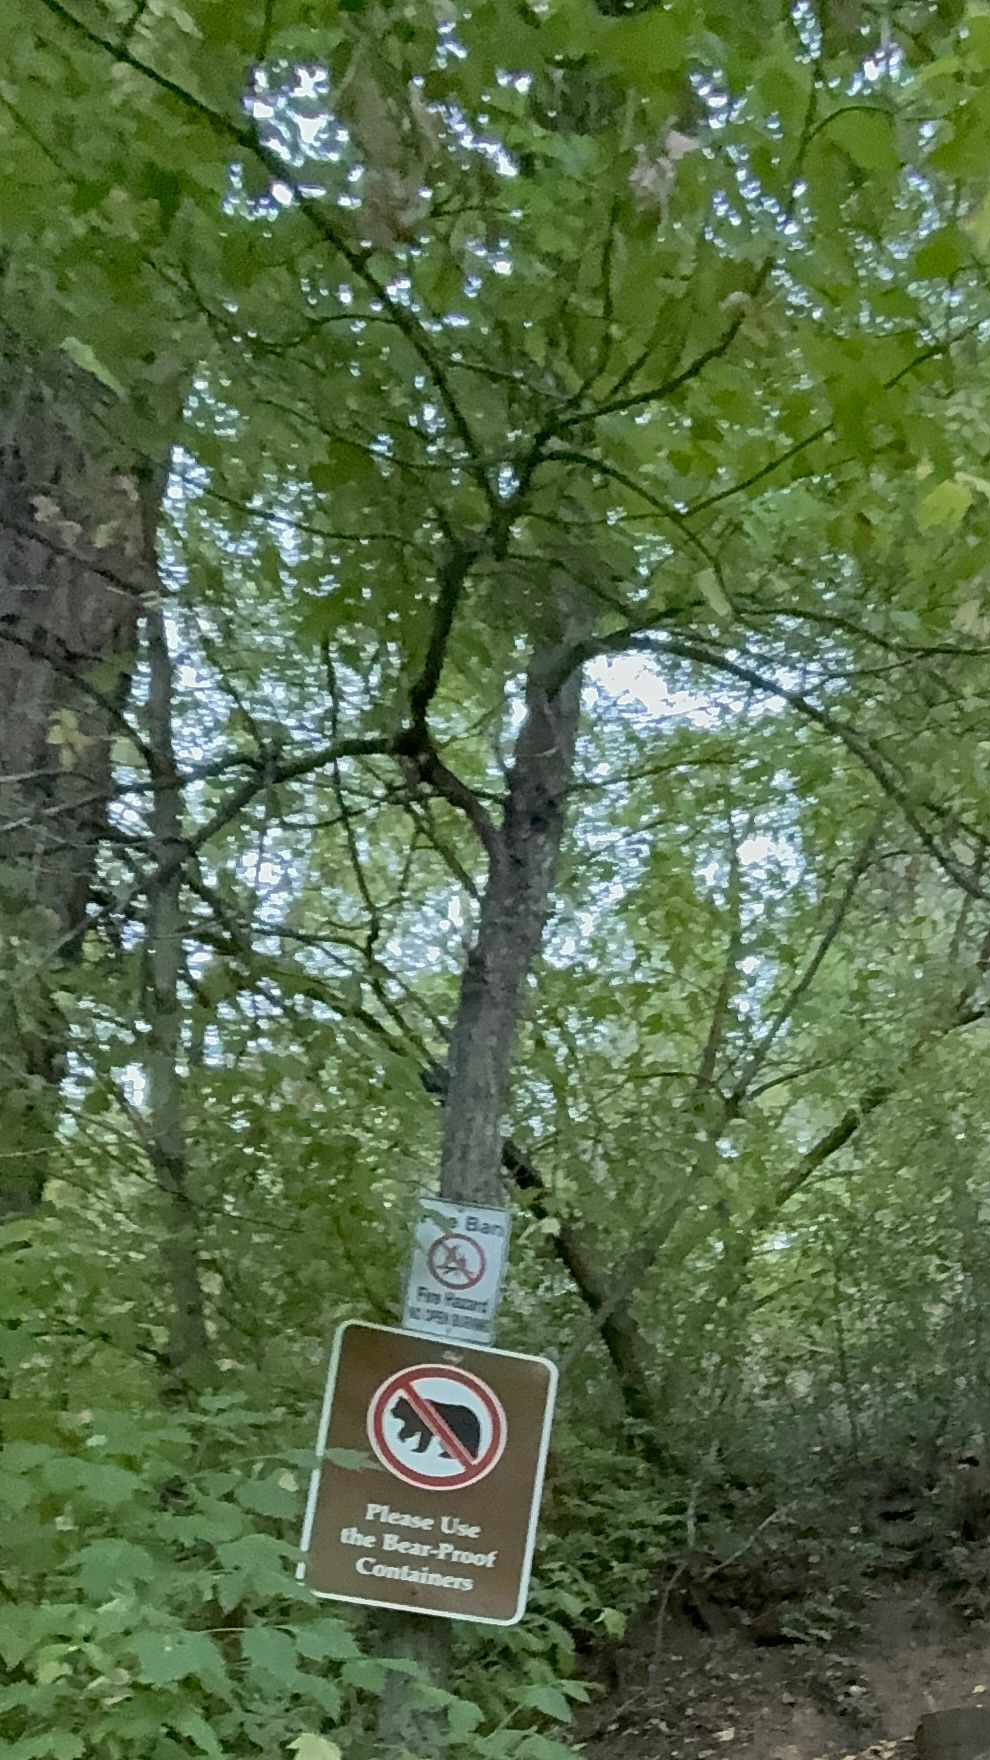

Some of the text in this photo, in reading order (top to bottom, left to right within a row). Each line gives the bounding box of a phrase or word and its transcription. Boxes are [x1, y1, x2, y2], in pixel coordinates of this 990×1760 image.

[466, 1216, 505, 1237] Ban
[365, 1503, 482, 1538] Please Use
[340, 1527, 498, 1568] the Bear-Proof
[355, 1556, 474, 1591] Containers
